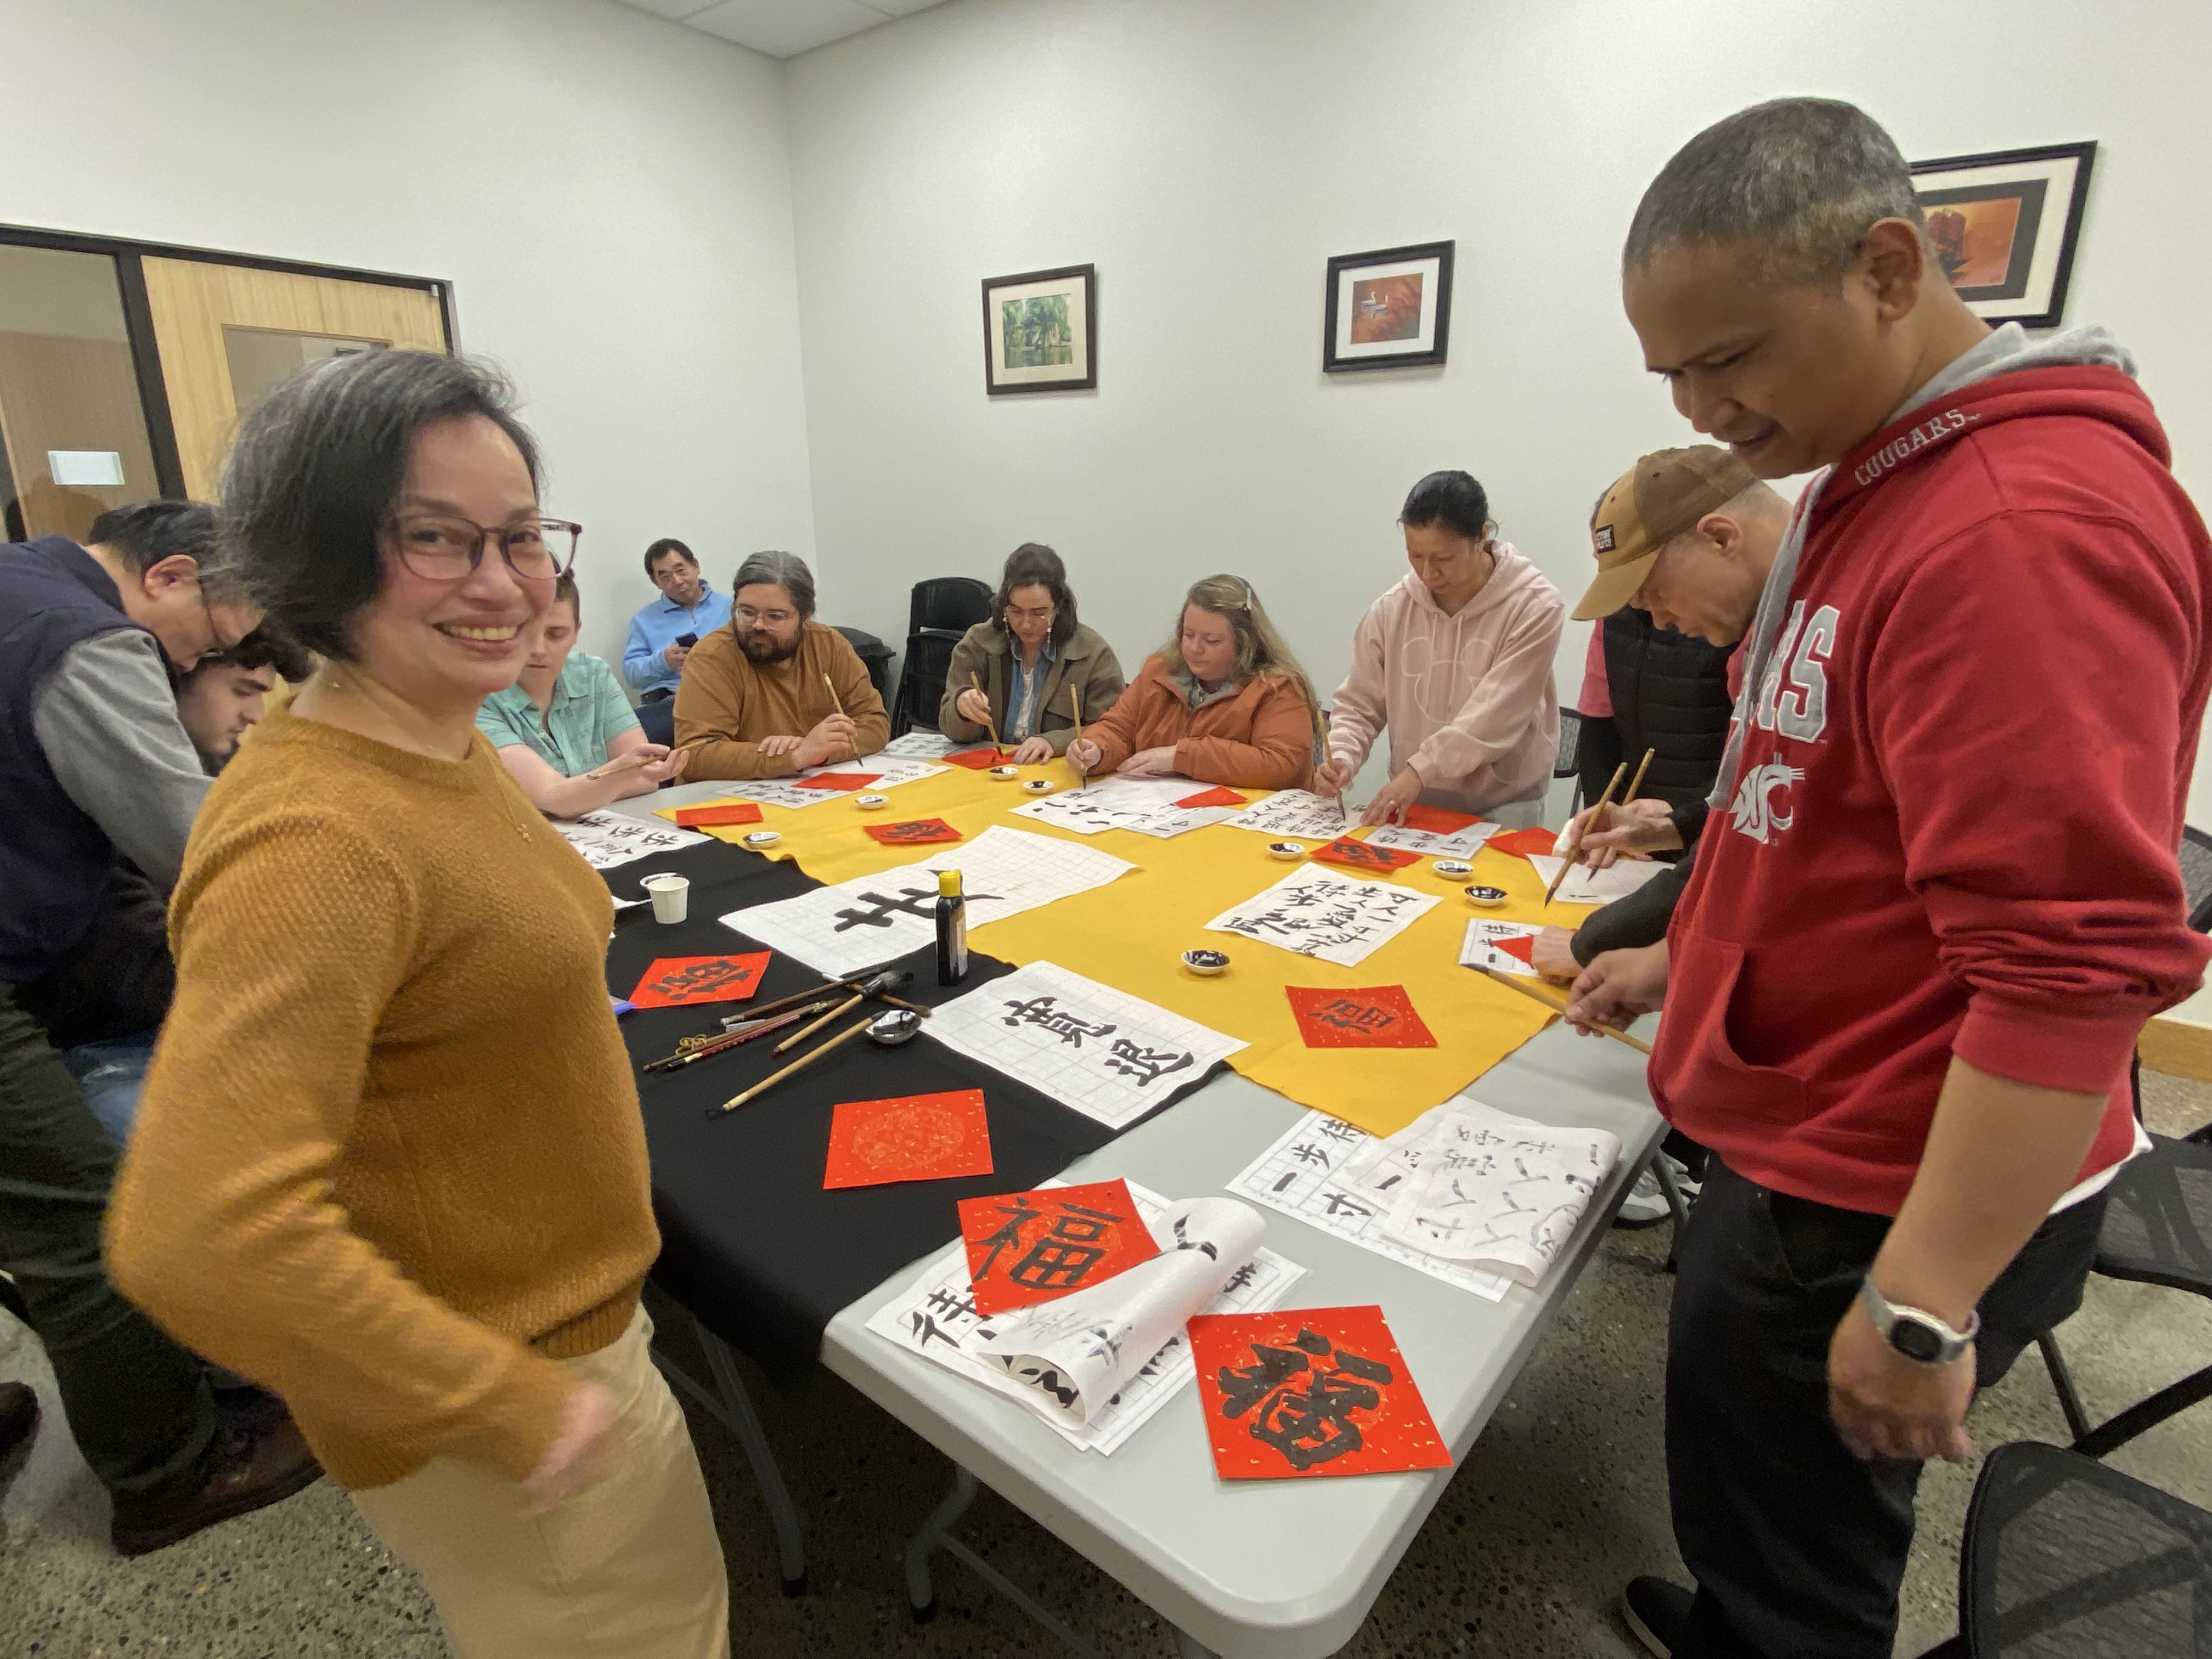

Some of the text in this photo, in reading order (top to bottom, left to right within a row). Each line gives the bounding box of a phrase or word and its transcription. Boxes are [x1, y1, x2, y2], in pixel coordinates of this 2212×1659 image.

[1855, 409, 1966, 486] COUGARS
[1310, 998, 1396, 1035] 福
[974, 1197, 1126, 1290] 福
[1216, 1324, 1394, 1473] 福
